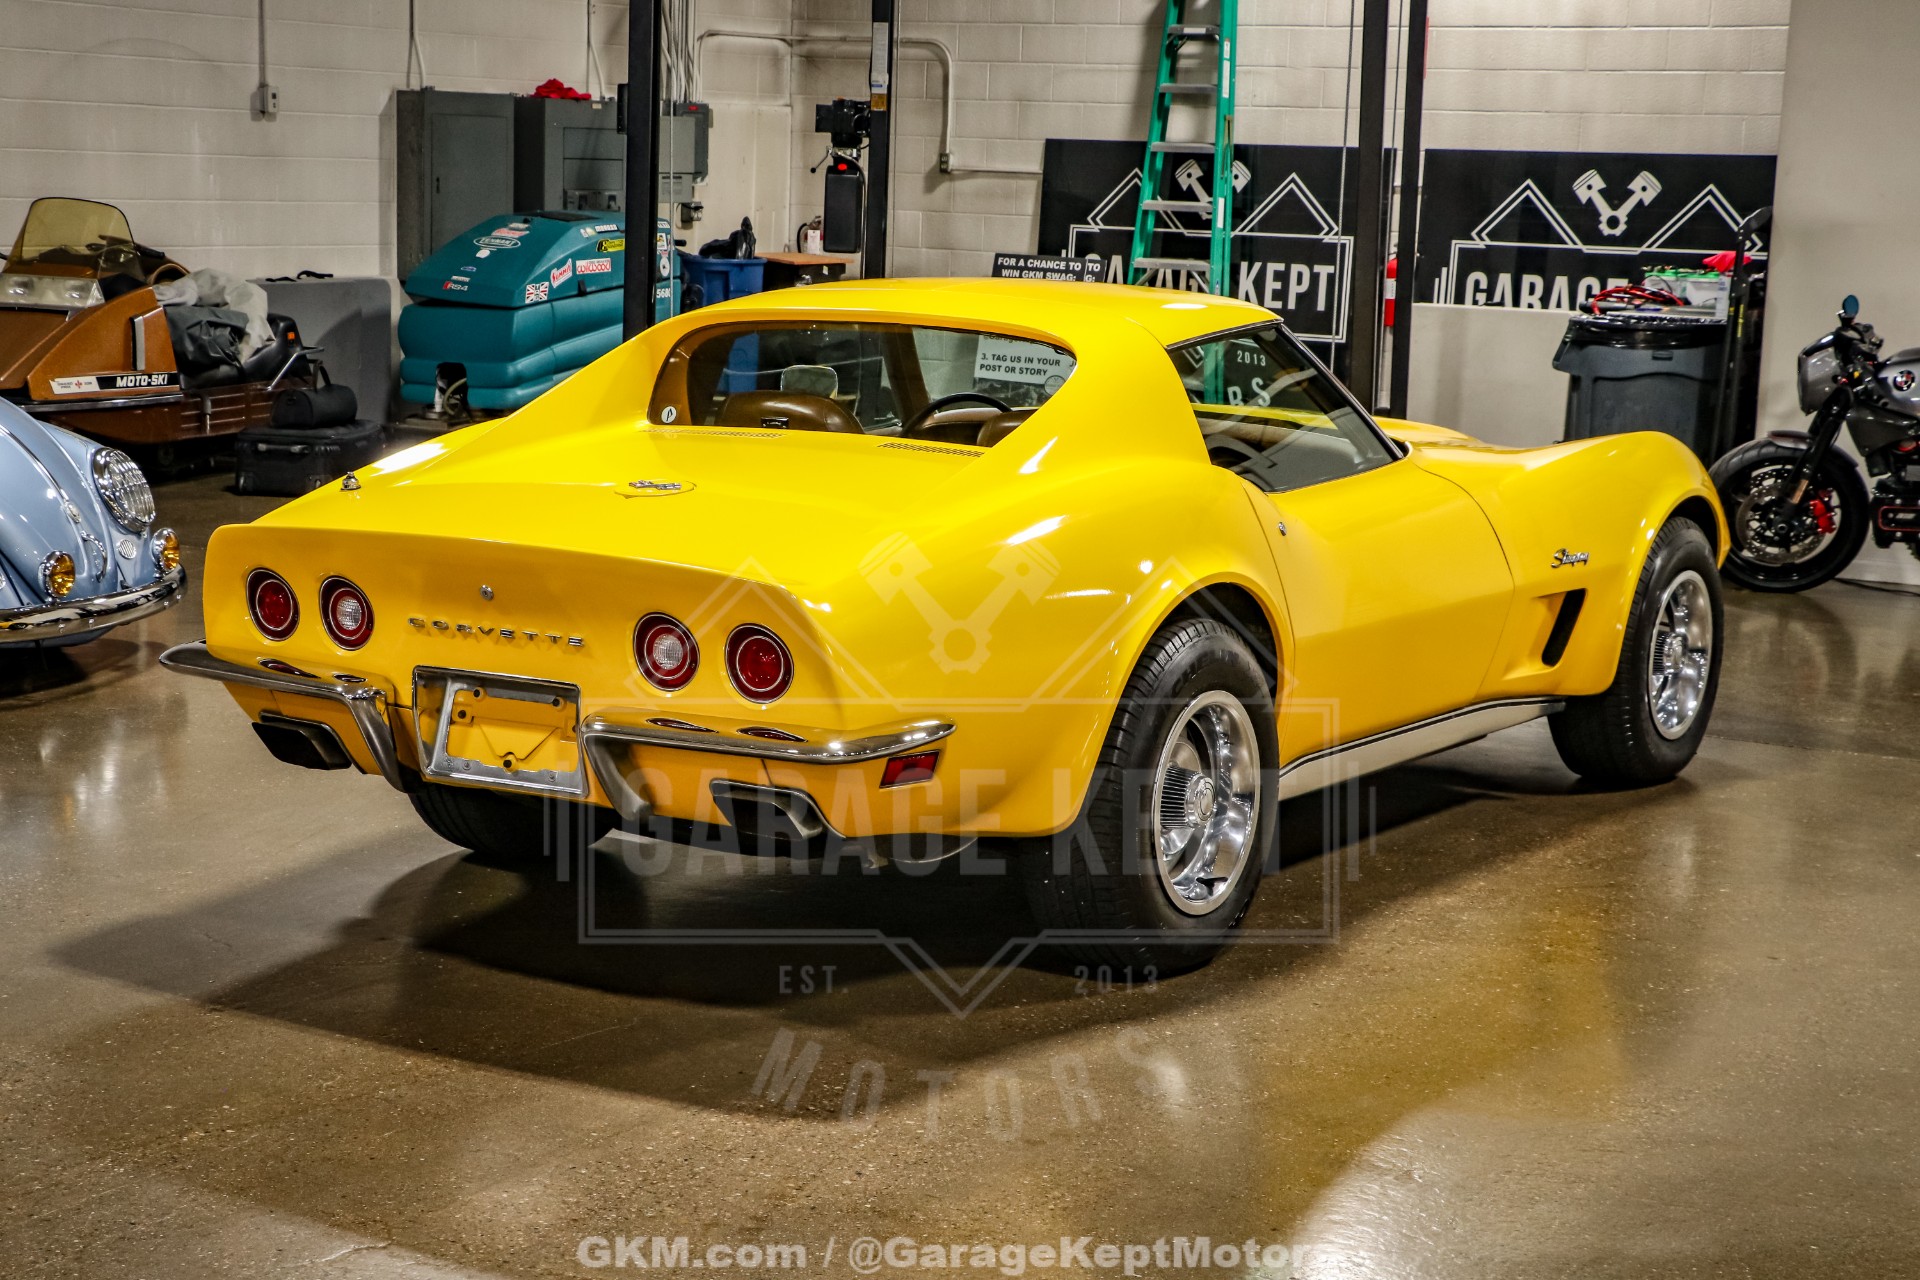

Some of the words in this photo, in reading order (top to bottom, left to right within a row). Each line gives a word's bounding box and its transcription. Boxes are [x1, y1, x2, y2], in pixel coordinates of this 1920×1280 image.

[997, 257, 1016, 266] FOR
[1018, 258, 1025, 267] A
[1027, 259, 1067, 270] CHANCE
[1069, 262, 1082, 271] TO
[1001, 268, 1020, 277] WIN
[1022, 270, 1044, 279] GKM
[1045, 272, 1077, 282] SWAG:
[1238, 261, 1335, 312] KEPT
[1464, 271, 1630, 312] GARAG
[991, 354, 1008, 362] TAG
[1010, 355, 1022, 363] US
[1037, 358, 1061, 366] YOUR
[1237, 350, 1267, 367] 2013
[979, 364, 1002, 372] POST
[1004, 365, 1016, 374] OR
[1019, 367, 1048, 376] STORY
[407, 616, 585, 648] CORVETTE
